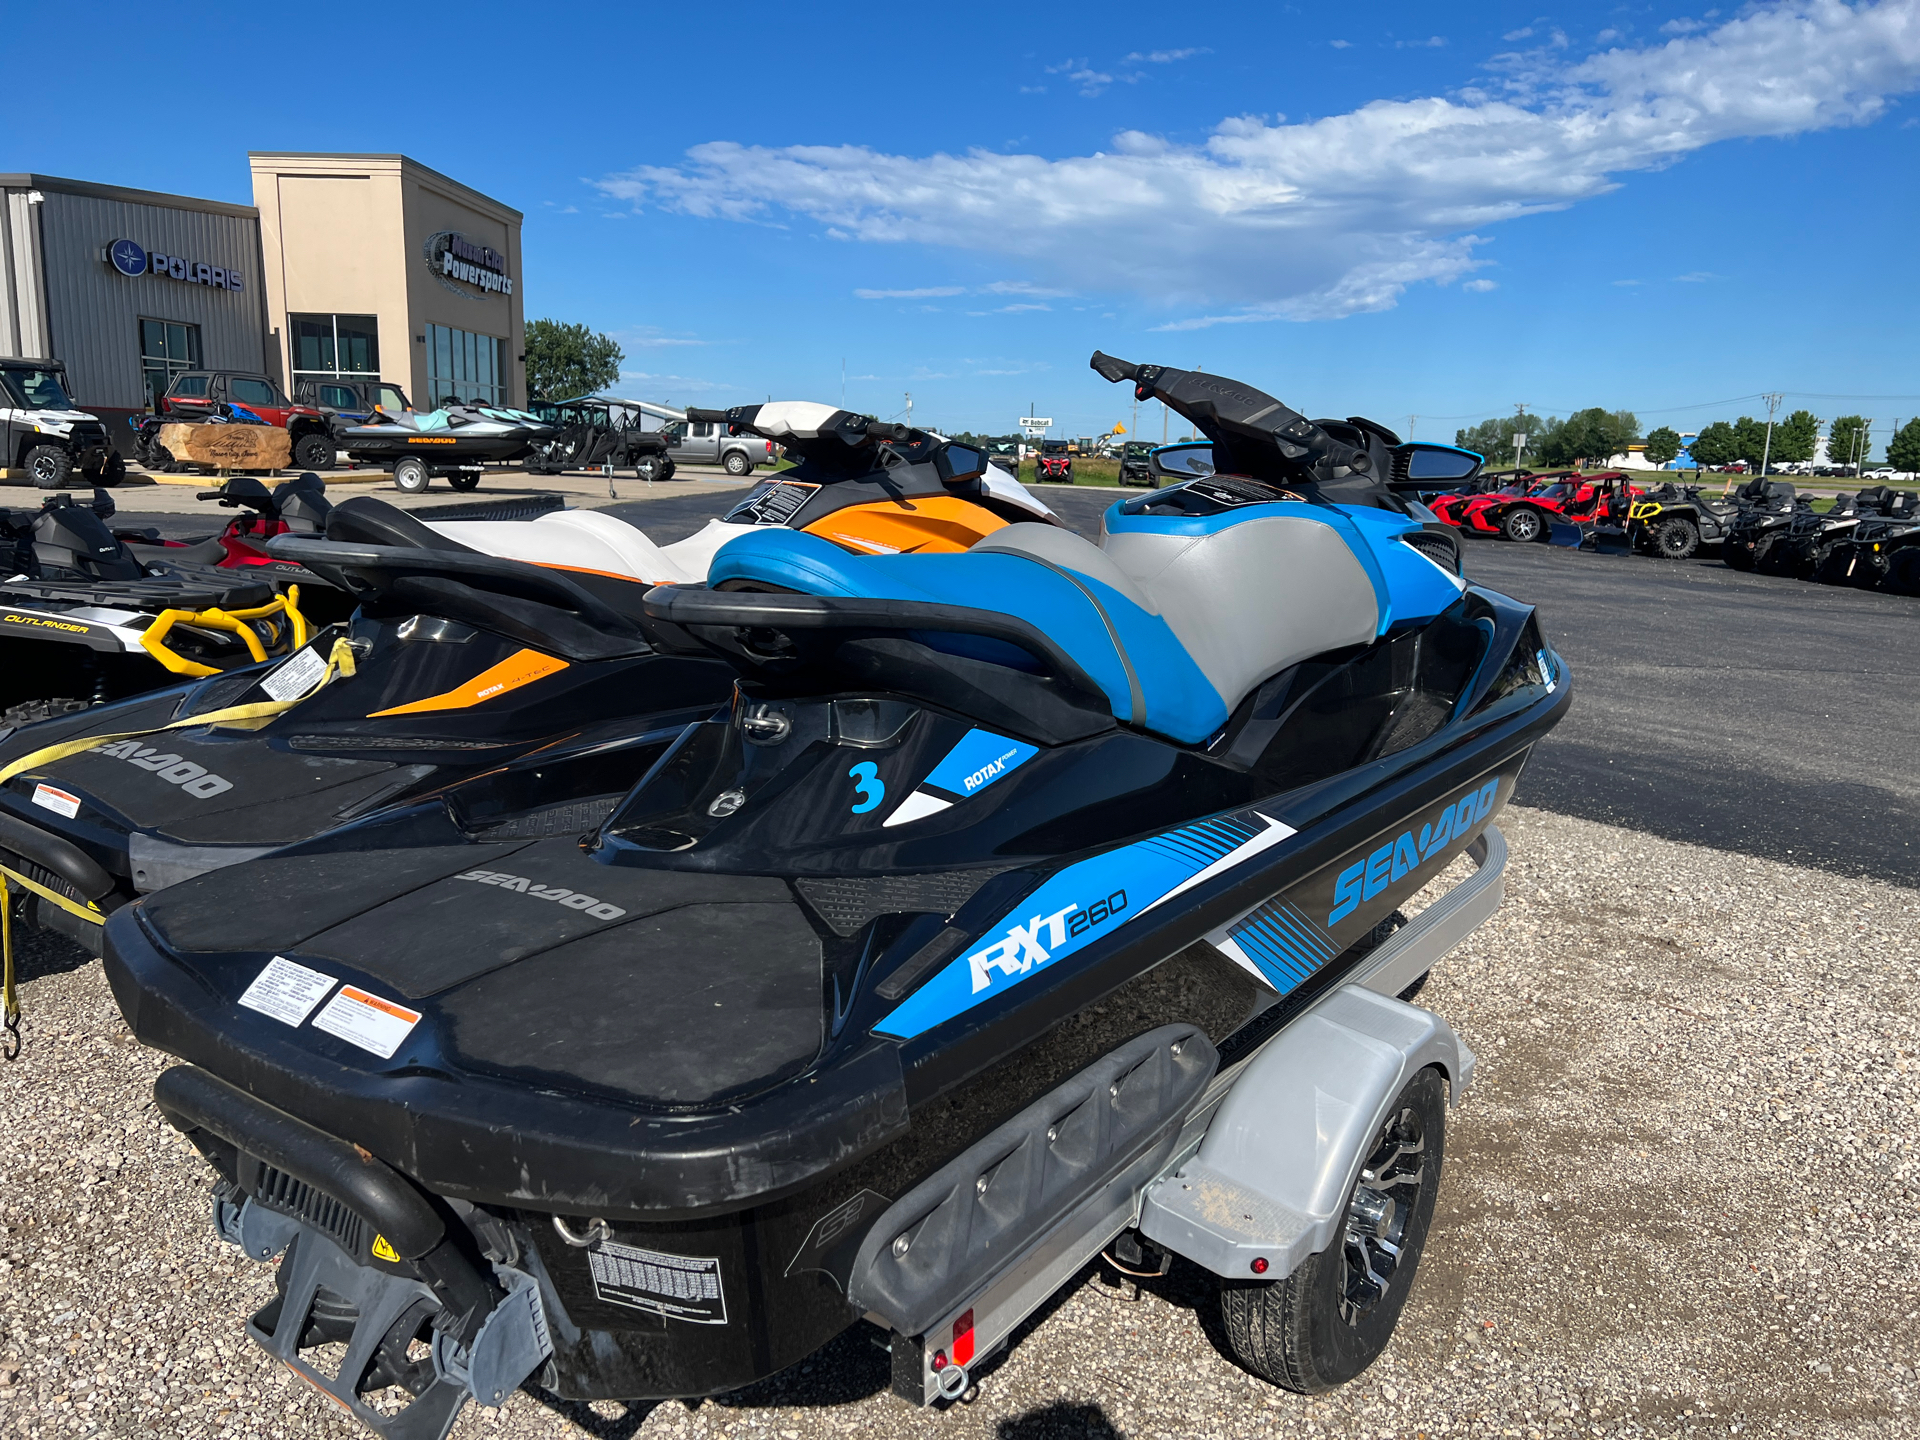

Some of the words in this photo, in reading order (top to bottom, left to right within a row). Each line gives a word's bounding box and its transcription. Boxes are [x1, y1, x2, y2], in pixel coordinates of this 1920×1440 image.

[151, 252, 245, 293] POLARIS
[443, 251, 513, 295] Powersports
[452, 234, 484, 264] Mason
[486, 247, 504, 274] City
[275, 564, 316, 576] OUTLAN
[4, 614, 90, 634] OUTLANDER
[477, 683, 505, 698] ROTAX
[511, 665, 551, 684] 4-TEC
[848, 761, 886, 815] 3
[963, 757, 1006, 791] ROTAX
[1001, 748, 1018, 761] POWER
[967, 903, 1078, 995] RXT
[1067, 888, 1128, 938] 260
[369, 998, 392, 1013] WARNING
